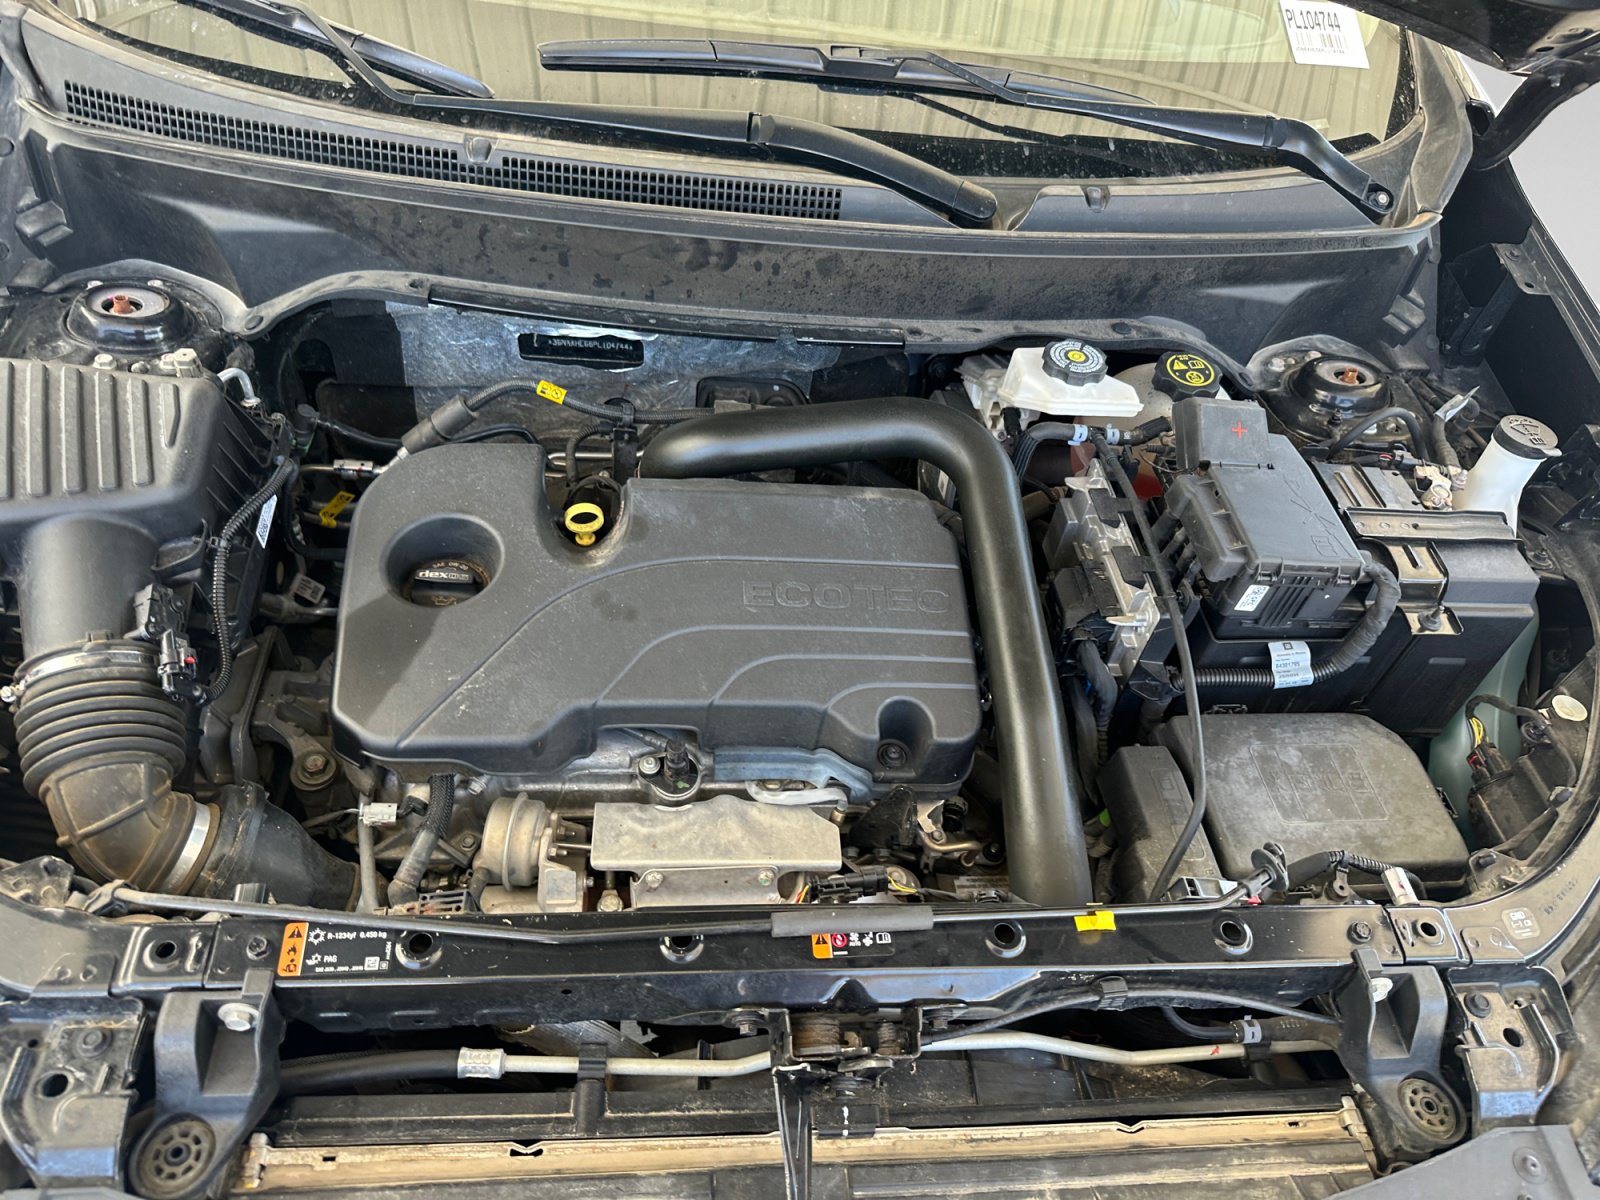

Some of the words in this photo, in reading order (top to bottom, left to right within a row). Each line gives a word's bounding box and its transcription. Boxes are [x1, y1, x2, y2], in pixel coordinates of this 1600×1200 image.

[1285, 8, 1341, 32] PL104744
[743, 580, 949, 613] ECOTEC
[327, 931, 357, 940] R-1234yf
[323, 955, 338, 963] PAG
